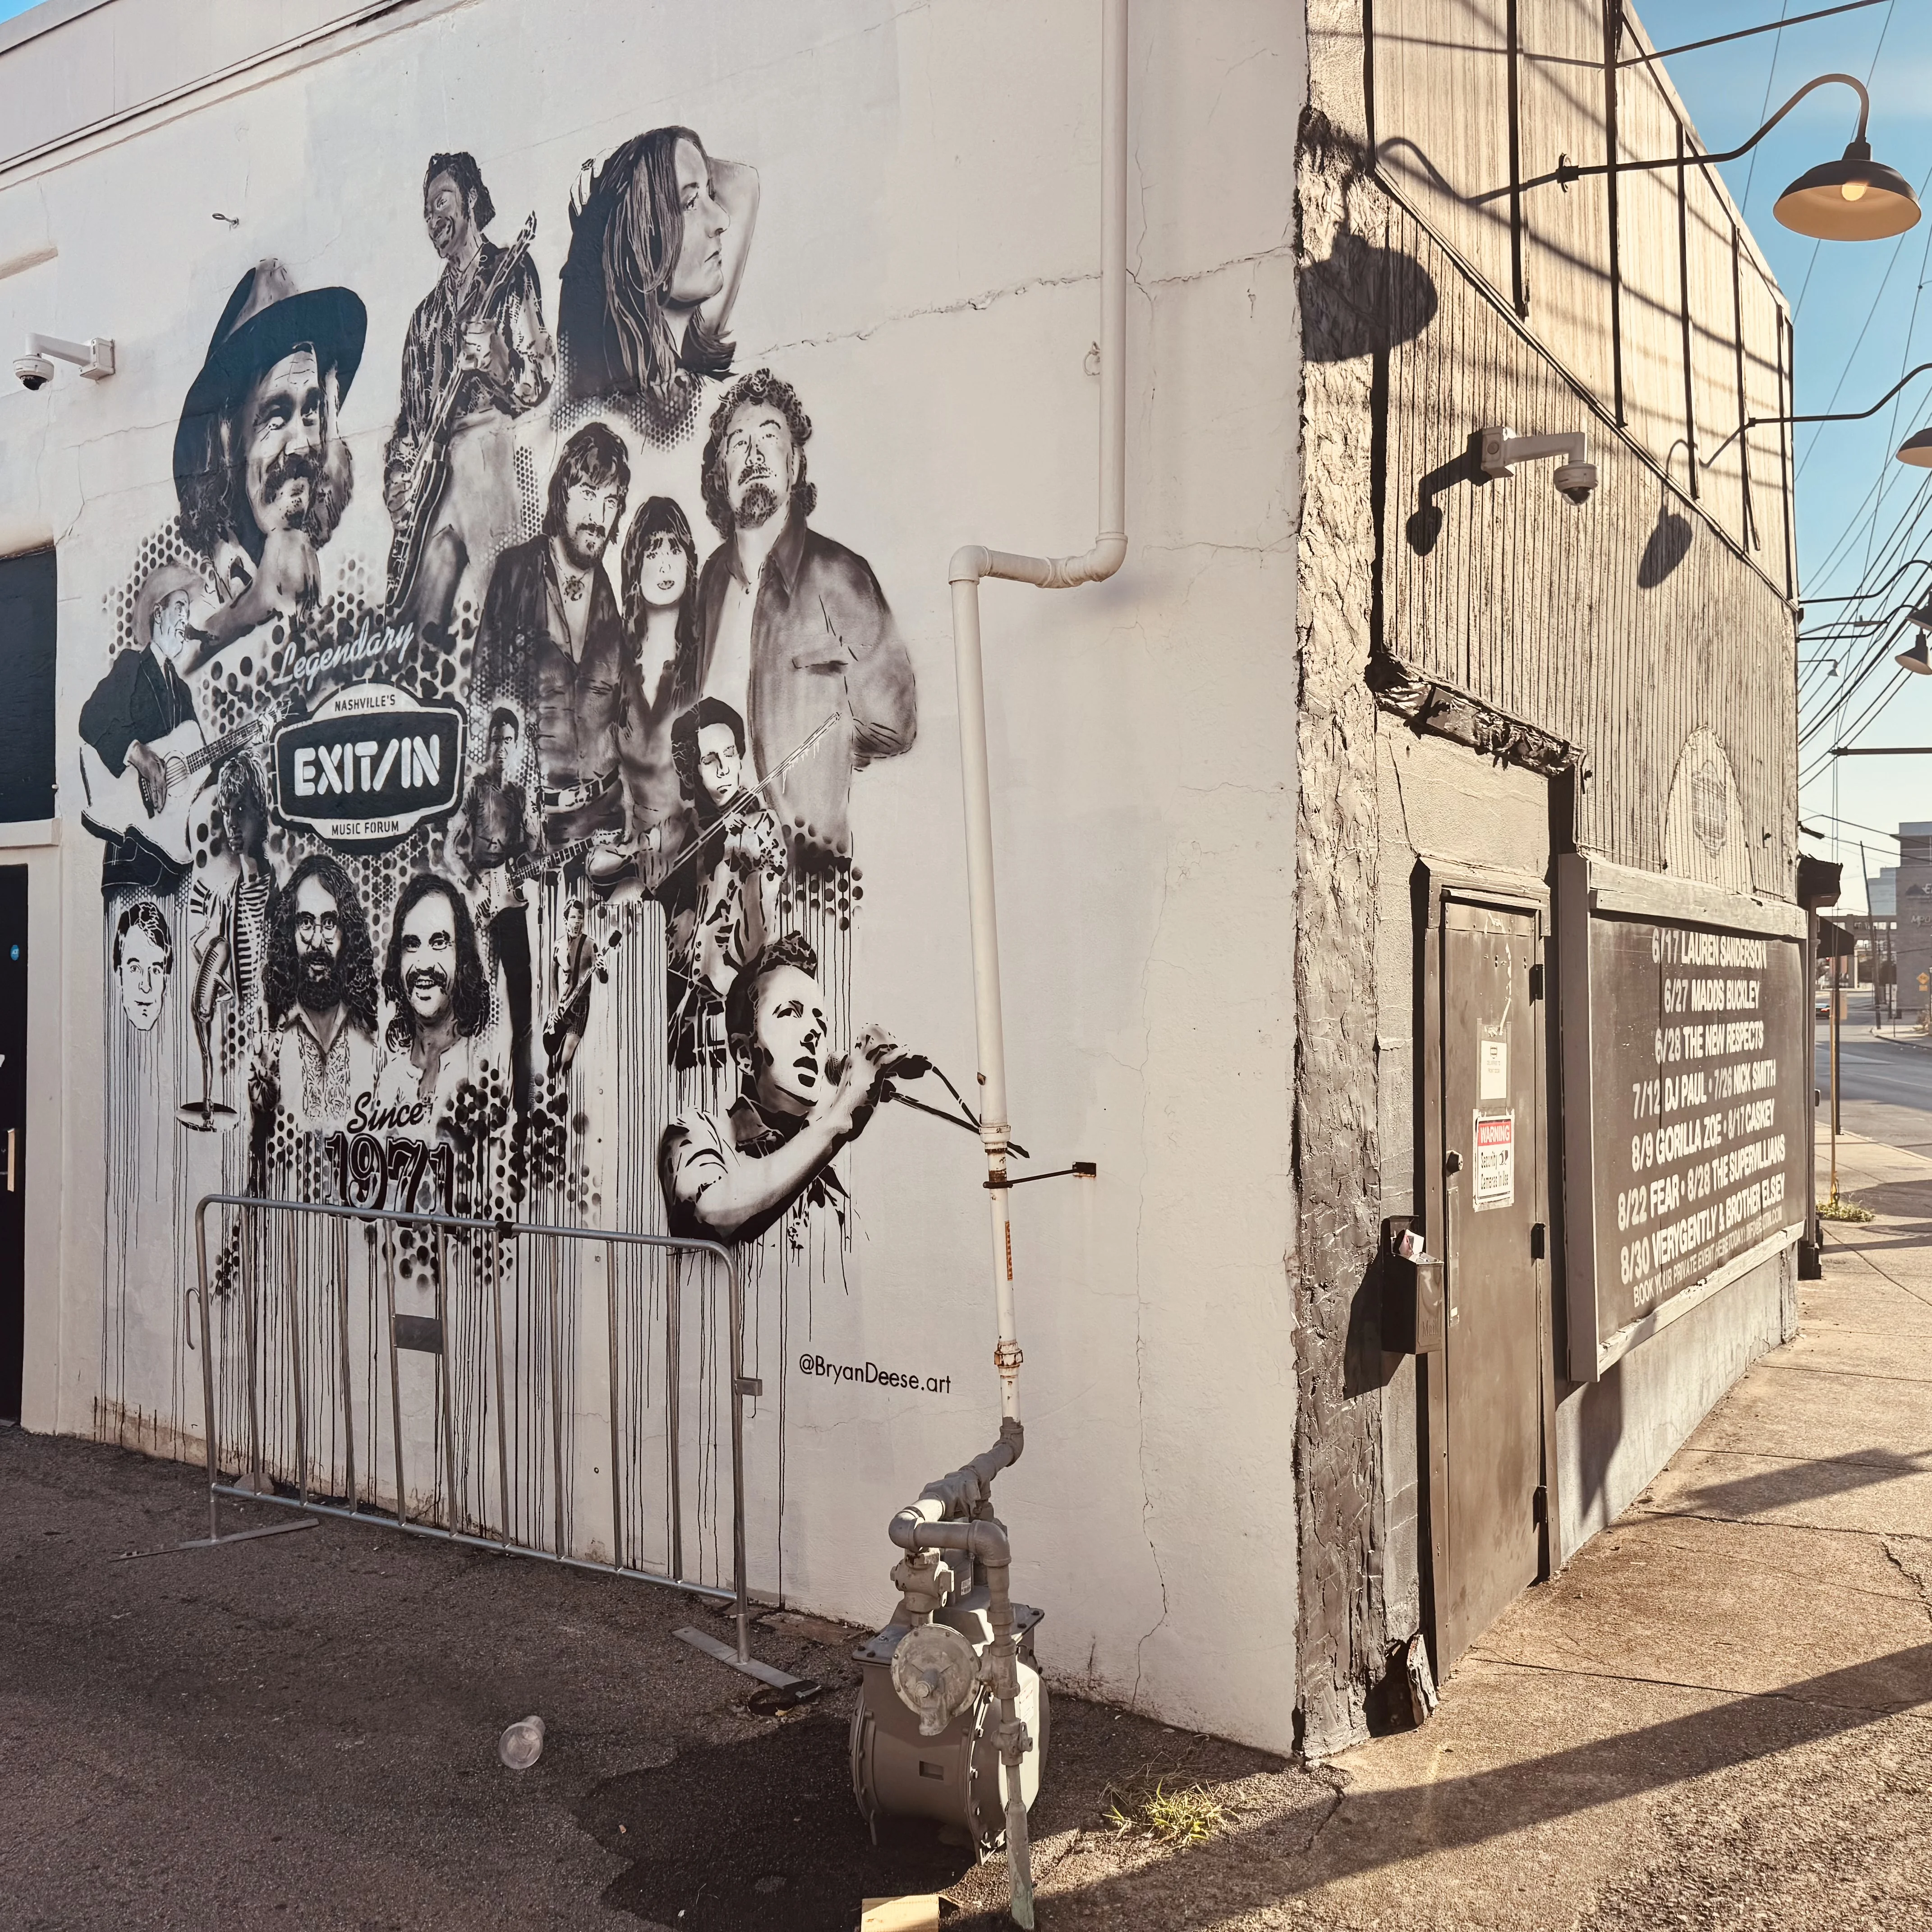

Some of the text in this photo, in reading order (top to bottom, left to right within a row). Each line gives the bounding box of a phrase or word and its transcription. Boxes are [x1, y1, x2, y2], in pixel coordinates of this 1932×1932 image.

[272, 616, 414, 691] Legendary
[335, 695, 396, 712] NASHVILLE'S
[294, 734, 440, 796] EXIT/IN
[331, 821, 399, 836] MUSIC FORUM
[1652, 928, 1766, 969] 6/17 LAUREN SANDERSON
[1665, 979, 1759, 1013] 6/27 MADDS BUCKLEY
[1655, 1020, 1763, 1064] 6/28 THE NEW RESPECTS
[1633, 1059, 1776, 1119] 7/12 DJ PAUL 7/26 NICK SMITH
[347, 1092, 424, 1134] Since
[1480, 1125, 1509, 1144] WARNING
[1632, 1098, 1774, 1172] 8/9 GORILLA ZOE 8/17 CASKEY
[1481, 1151, 1497, 1170] Security
[1481, 1173, 1497, 1190] Cameras
[324, 1131, 456, 1235] 1971
[1618, 1134, 1785, 1231] 8/22 FEAR 8/28 THE SUPERVILLIANS
[1621, 1172, 1785, 1284] 8/30 VERYGENTLY & BROTHER ELSEY
[1633, 1277, 1654, 1307] BOOK
[1655, 1268, 1672, 1295] YOUR
[1674, 1254, 1697, 1285] PRIVATE
[1697, 1243, 1715, 1270] EVENT
[1715, 1235, 1729, 1260] HERE
[799, 1353, 951, 1394] @BryanDeese.art
